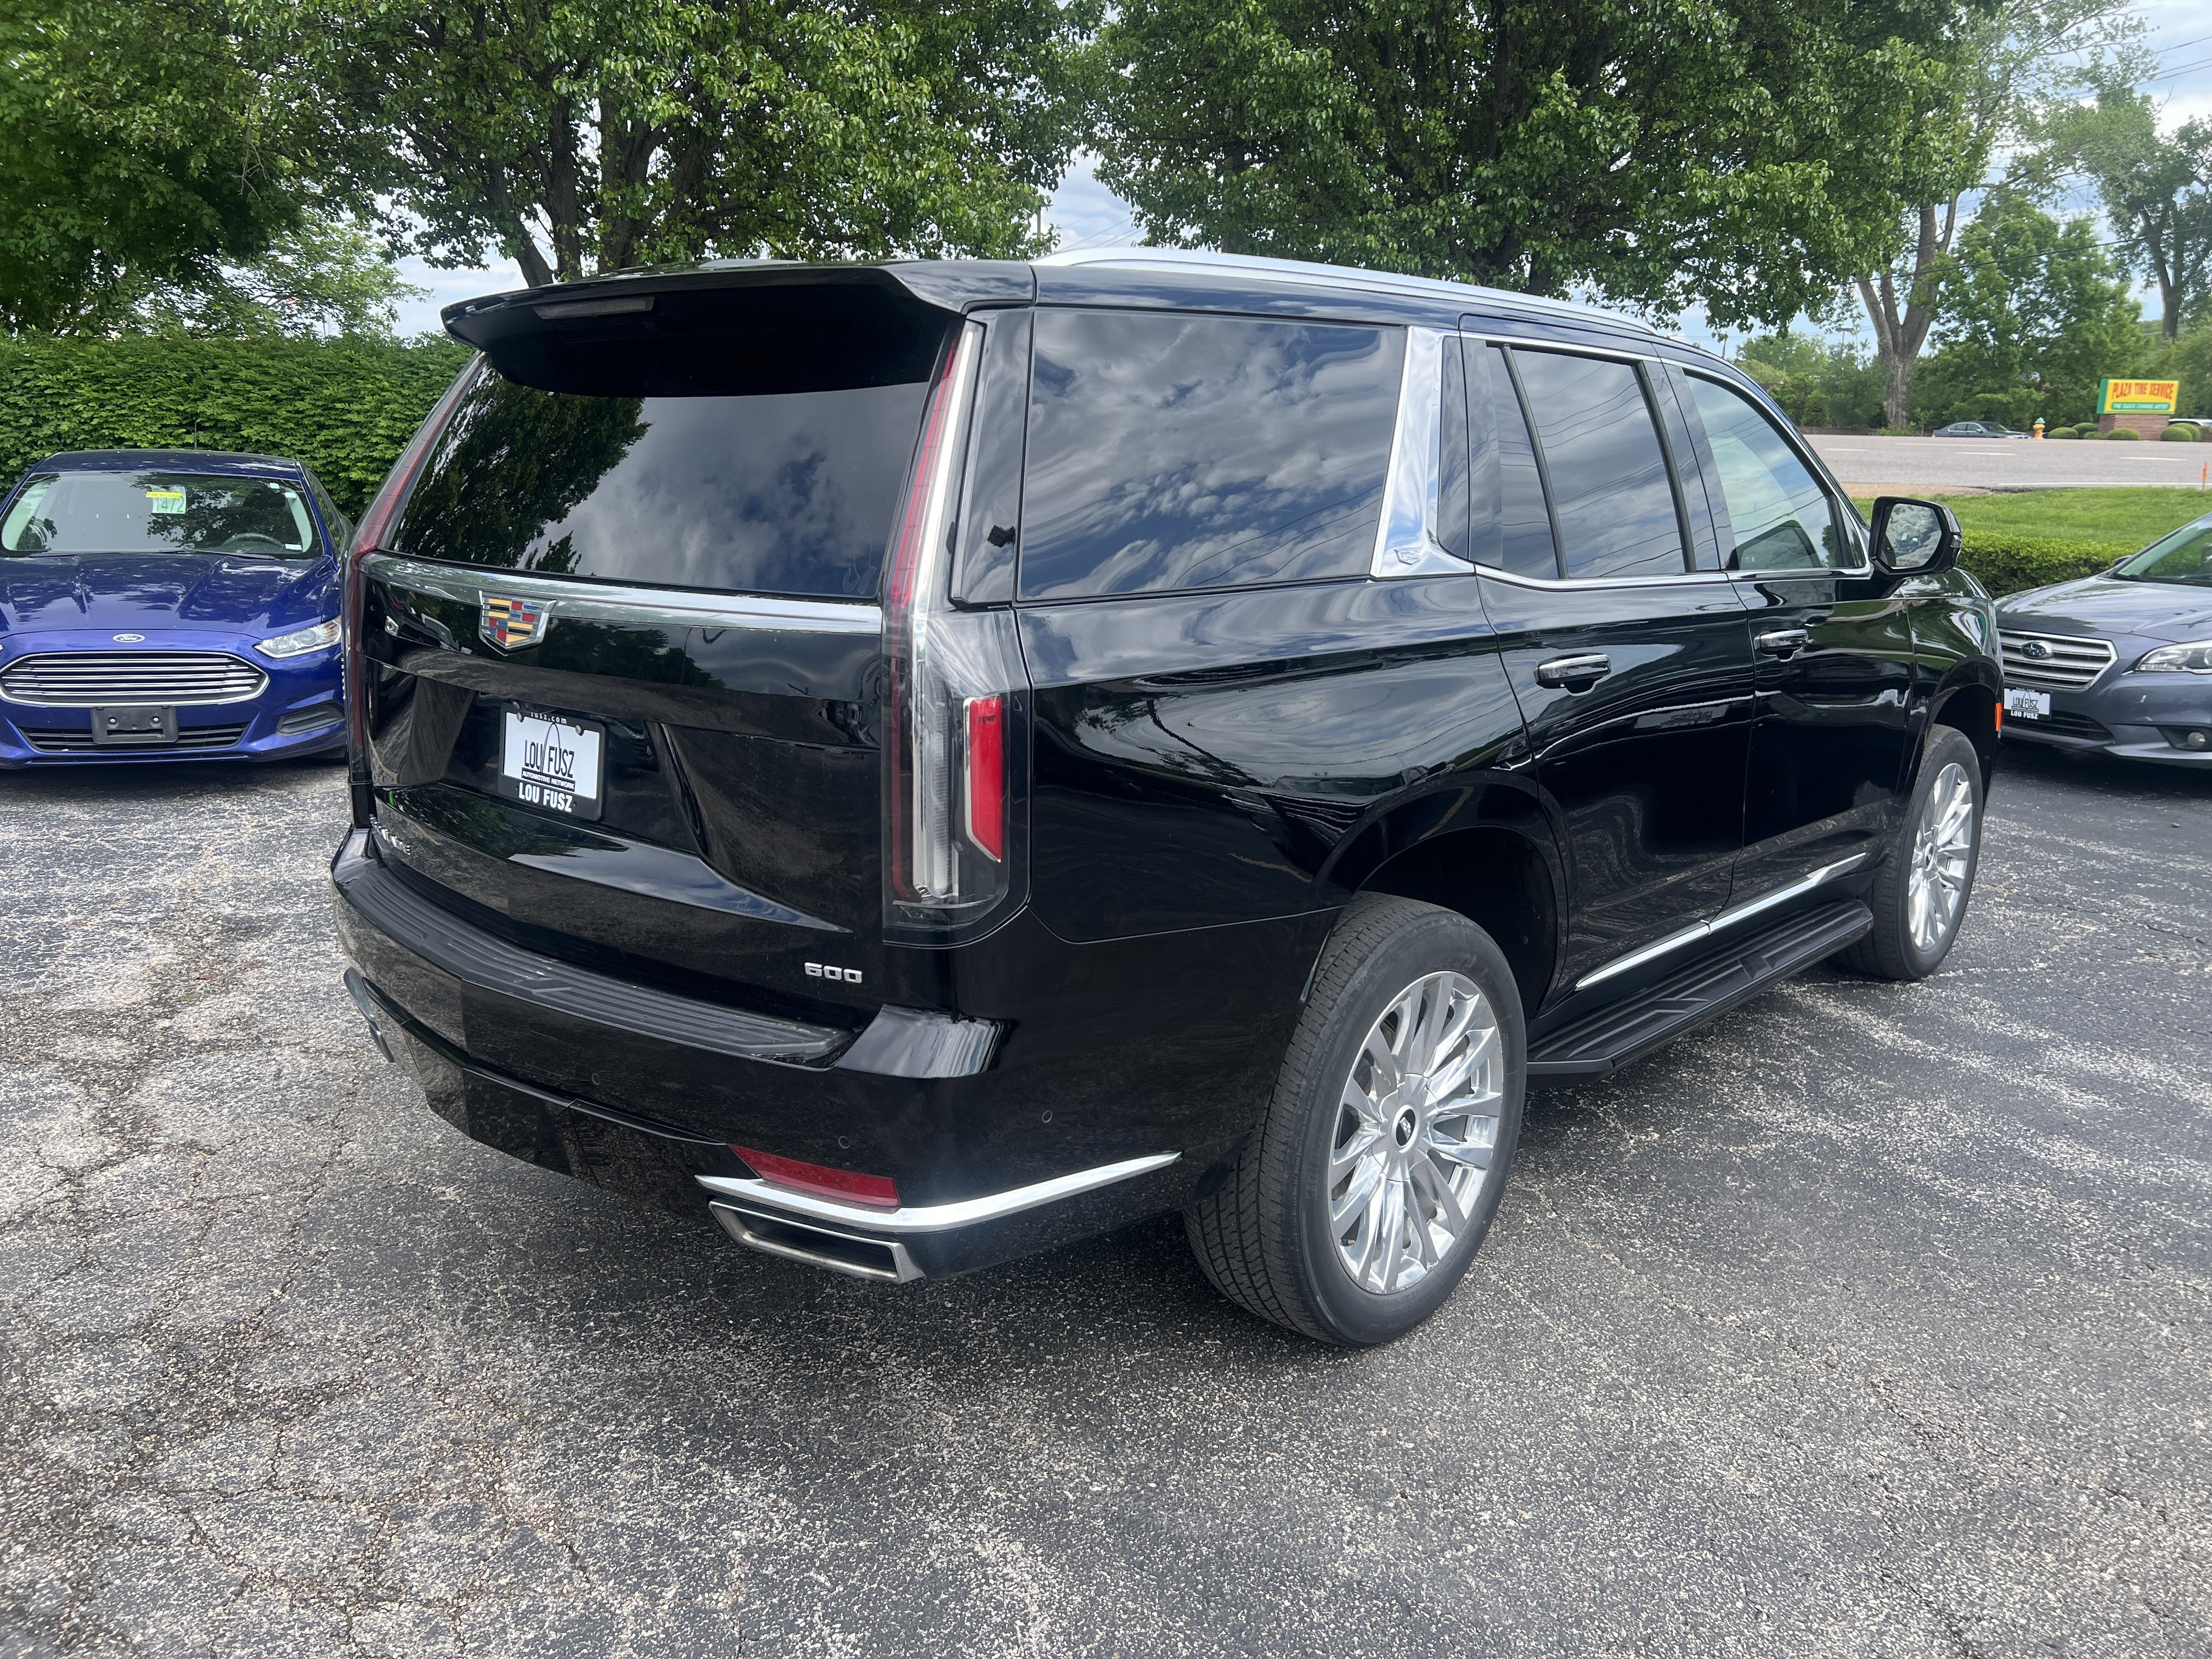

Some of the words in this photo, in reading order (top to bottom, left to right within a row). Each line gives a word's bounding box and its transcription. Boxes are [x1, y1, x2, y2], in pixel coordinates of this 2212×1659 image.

[2112, 382, 2131, 399] PLAZA
[2135, 383, 2147, 395] TIRE
[2149, 383, 2174, 400] SERVICE
[2013, 697, 2023, 706] LOU
[2025, 699, 2038, 708] FUSZ
[524, 740, 543, 770] LOU
[548, 746, 574, 778] FUSZ
[522, 771, 550, 783] AUTOMOTIVE
[551, 778, 574, 789] NETWORK
[518, 782, 540, 803] LOU
[543, 789, 572, 812] FUSZ
[804, 962, 862, 984] 600
